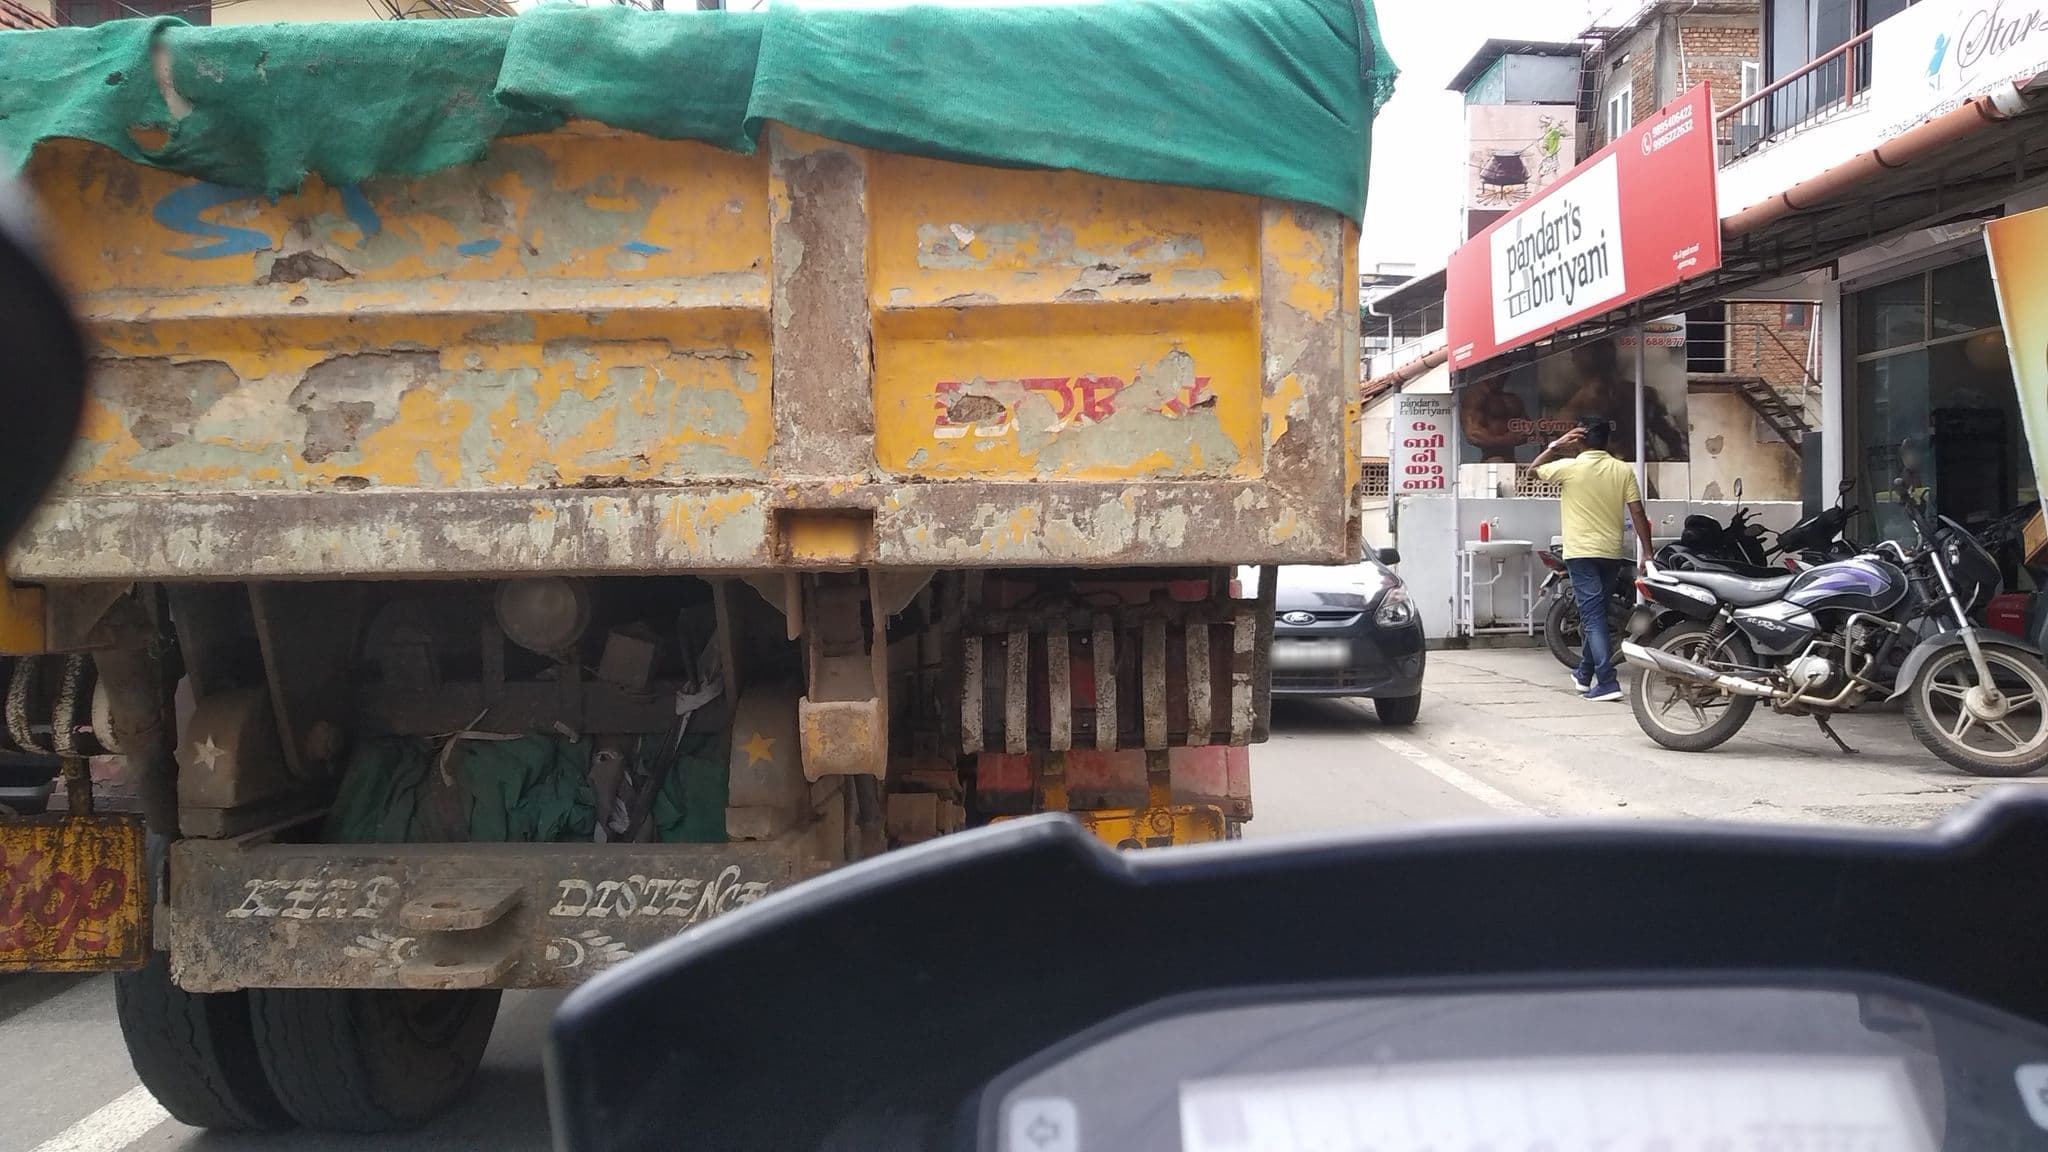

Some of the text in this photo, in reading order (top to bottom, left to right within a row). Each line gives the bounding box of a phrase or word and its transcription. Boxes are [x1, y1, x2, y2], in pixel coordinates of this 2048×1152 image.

[1507, 199, 1581, 293] pandari's
[1530, 228, 1608, 306] biriyani
[1413, 406, 1451, 417] biriyani
